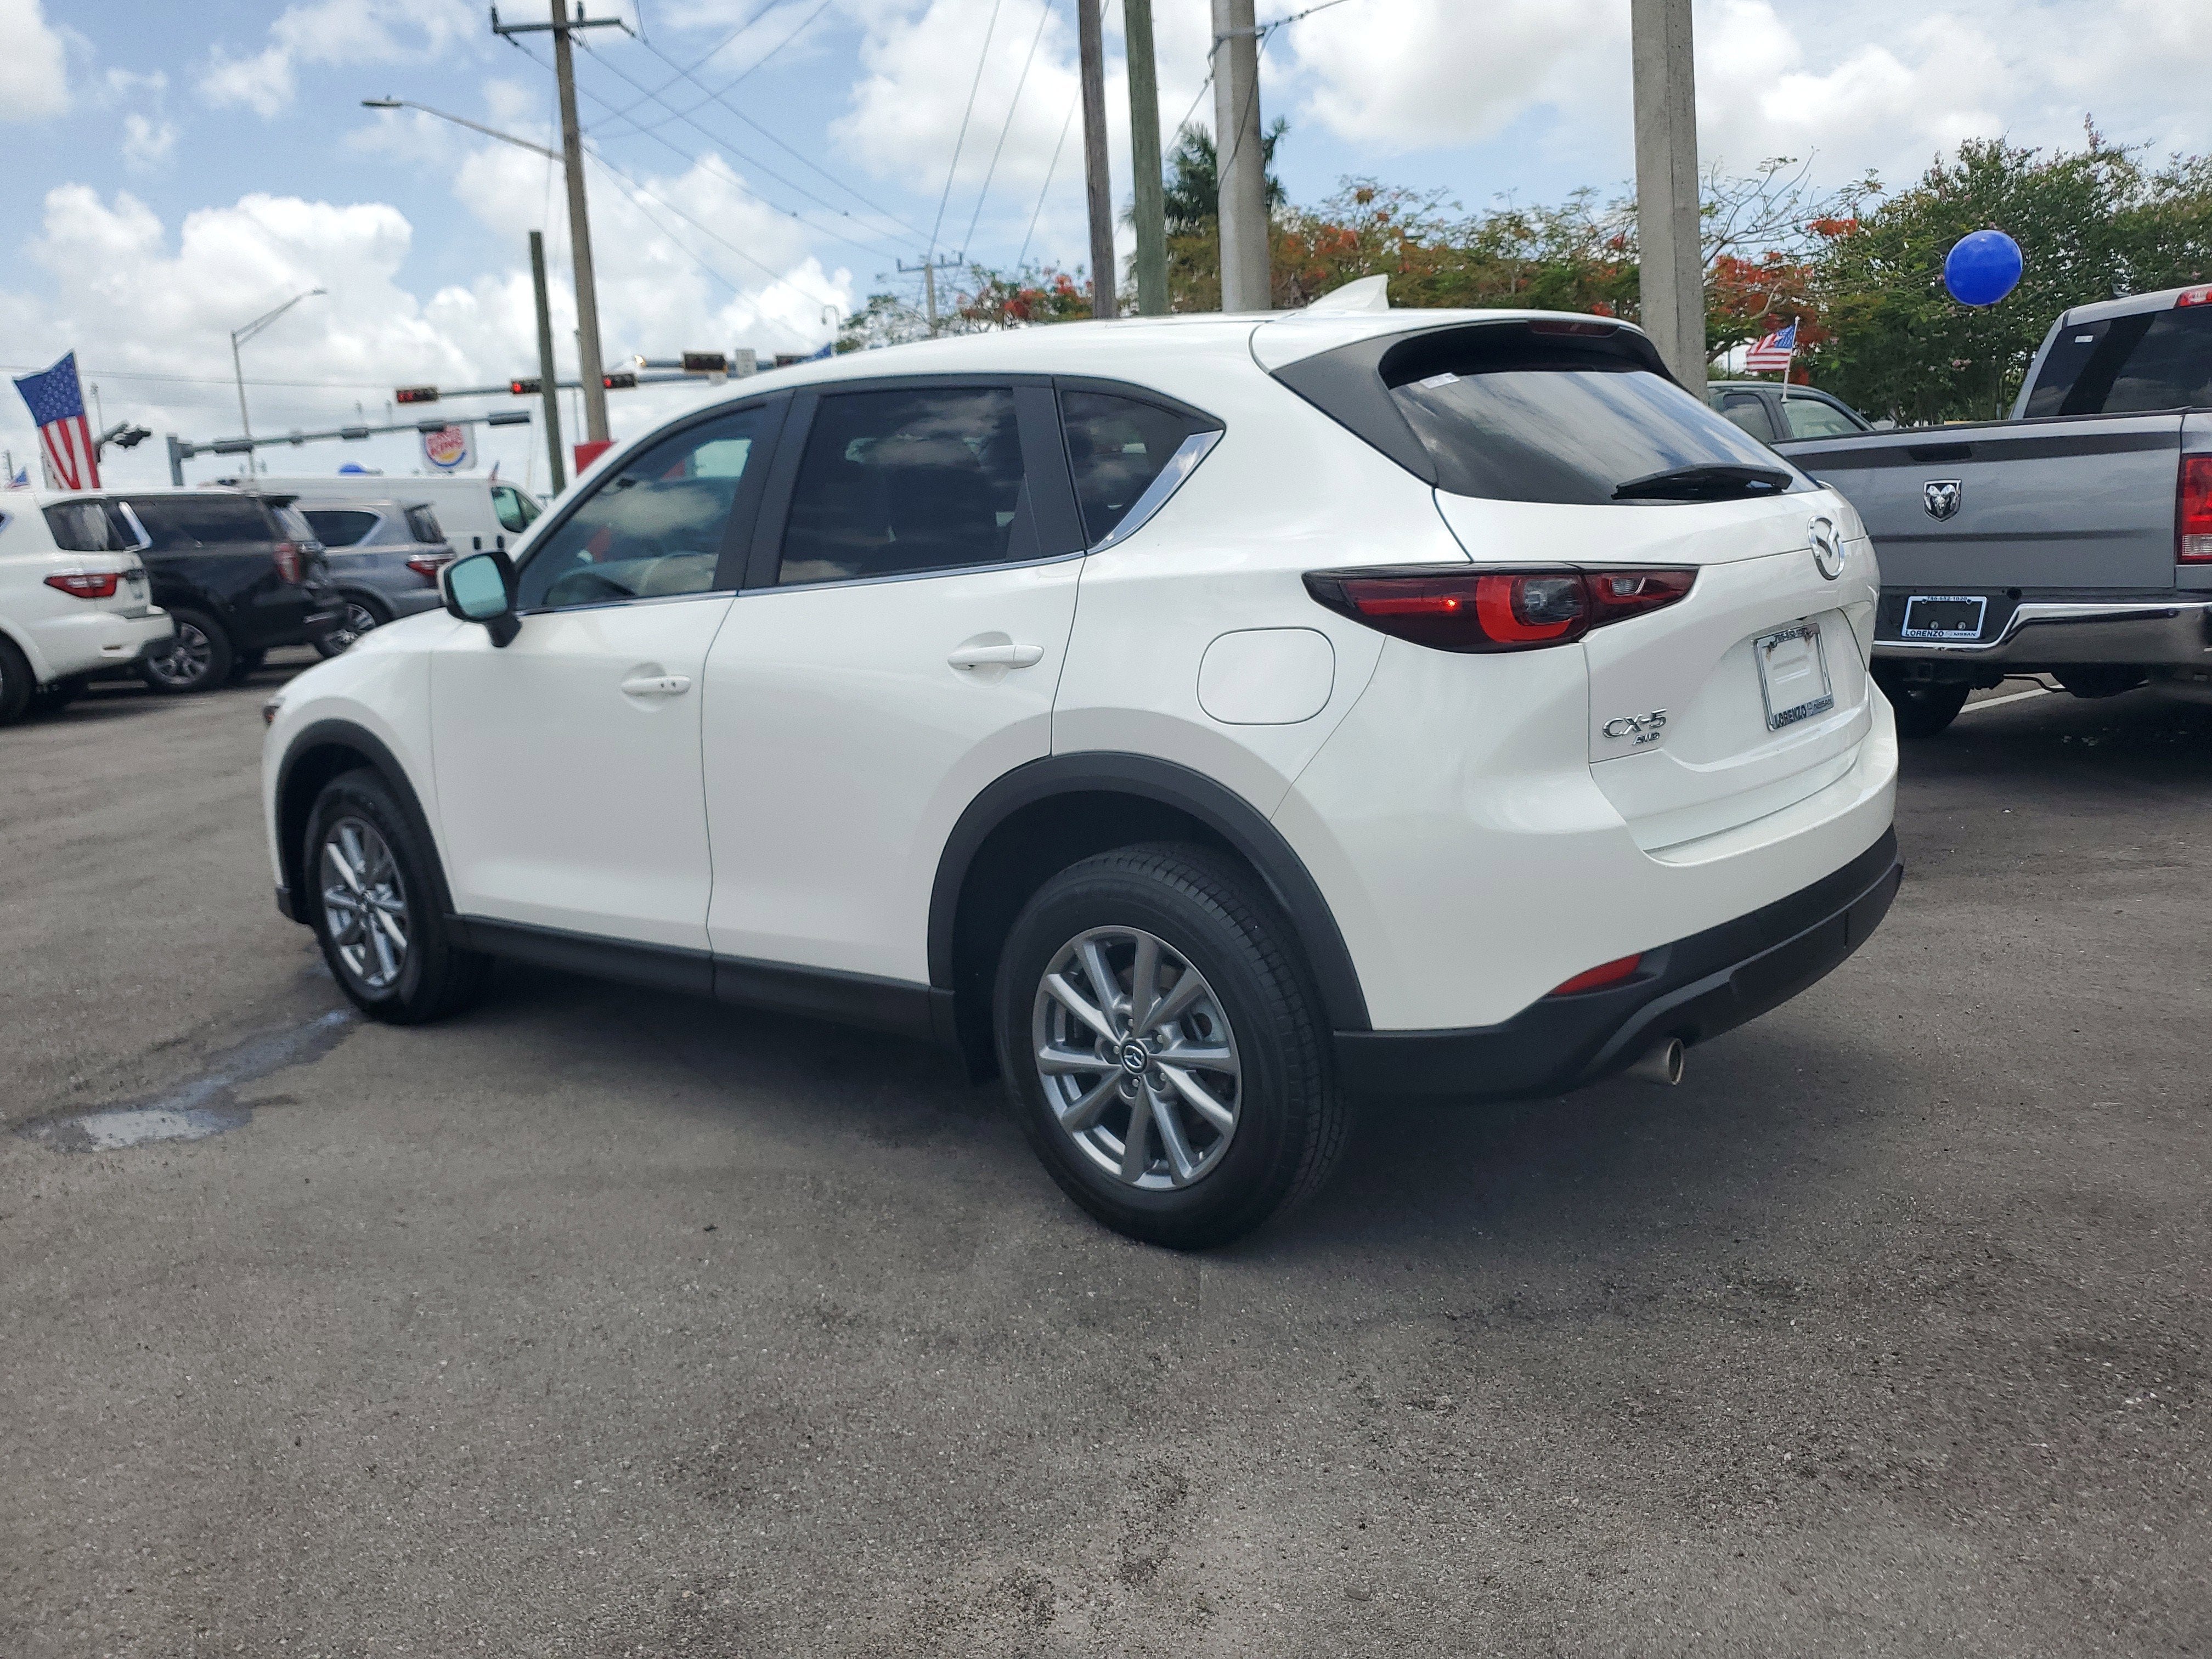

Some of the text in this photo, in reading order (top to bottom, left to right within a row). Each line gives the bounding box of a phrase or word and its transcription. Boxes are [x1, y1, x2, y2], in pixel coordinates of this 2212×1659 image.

[1602, 708, 1667, 738] CX-5
[1774, 704, 1807, 729] LORENZO
[1631, 732, 1660, 746] AWD
